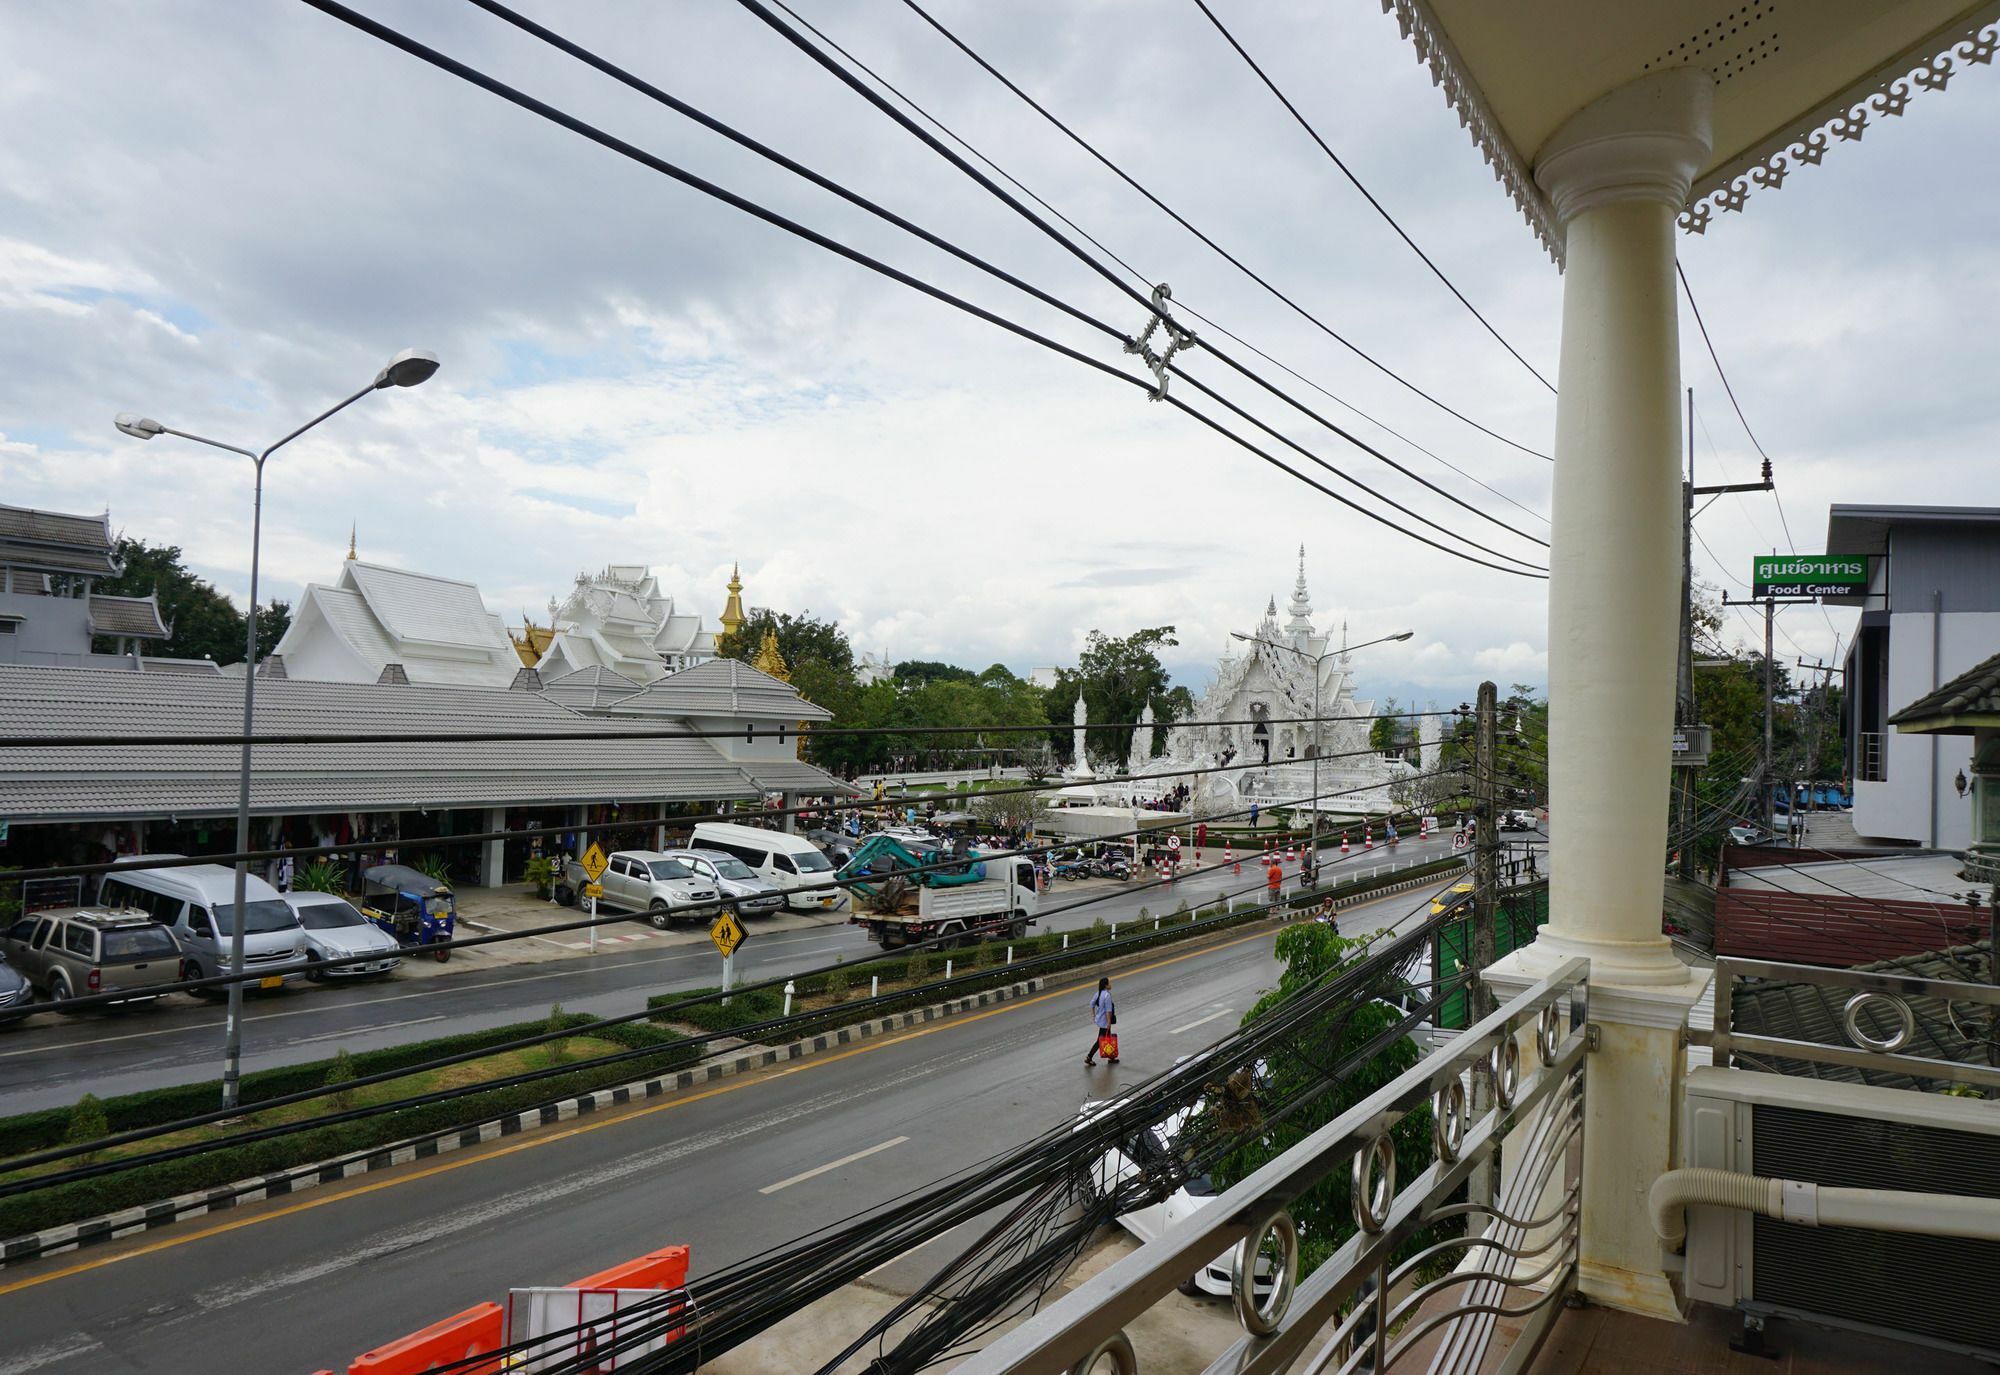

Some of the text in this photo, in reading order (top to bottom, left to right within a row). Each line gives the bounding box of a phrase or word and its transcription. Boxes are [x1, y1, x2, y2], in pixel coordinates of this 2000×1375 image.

[1759, 558, 1863, 579] ศูนย์อาหาร
[1768, 584, 1851, 595] Food Center
